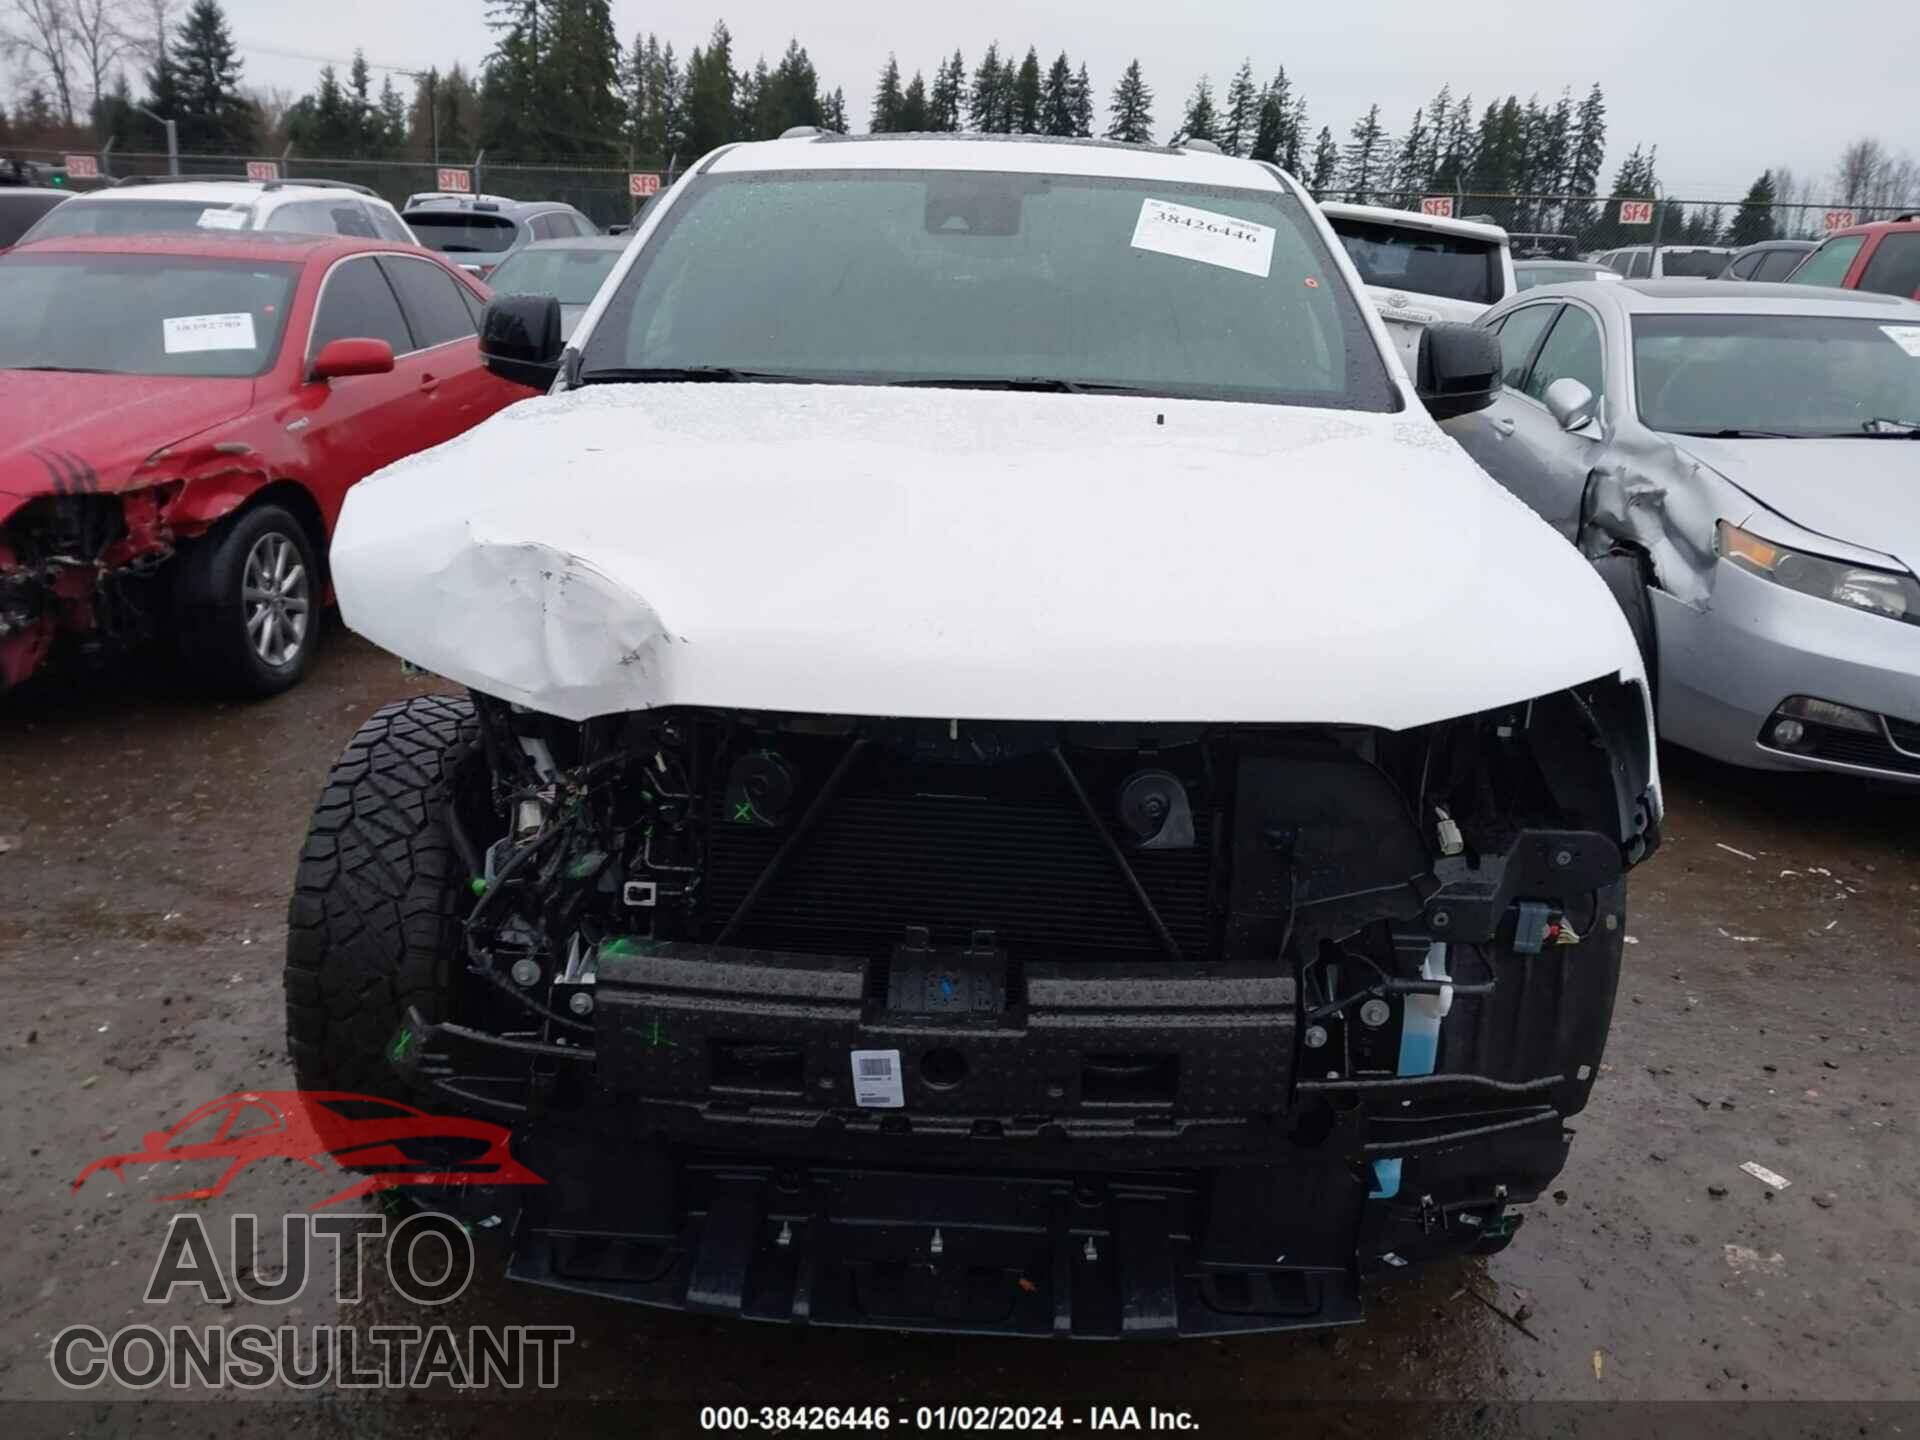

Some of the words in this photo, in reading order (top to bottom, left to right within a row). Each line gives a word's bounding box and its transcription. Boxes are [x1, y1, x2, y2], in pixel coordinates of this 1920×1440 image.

[440, 170, 468, 189] SF10
[631, 175, 658, 193] SF9
[1423, 199, 1450, 216] SF5
[1622, 203, 1649, 221] SF4
[1153, 210, 1258, 244] 38426446
[1824, 211, 1852, 230] SF3
